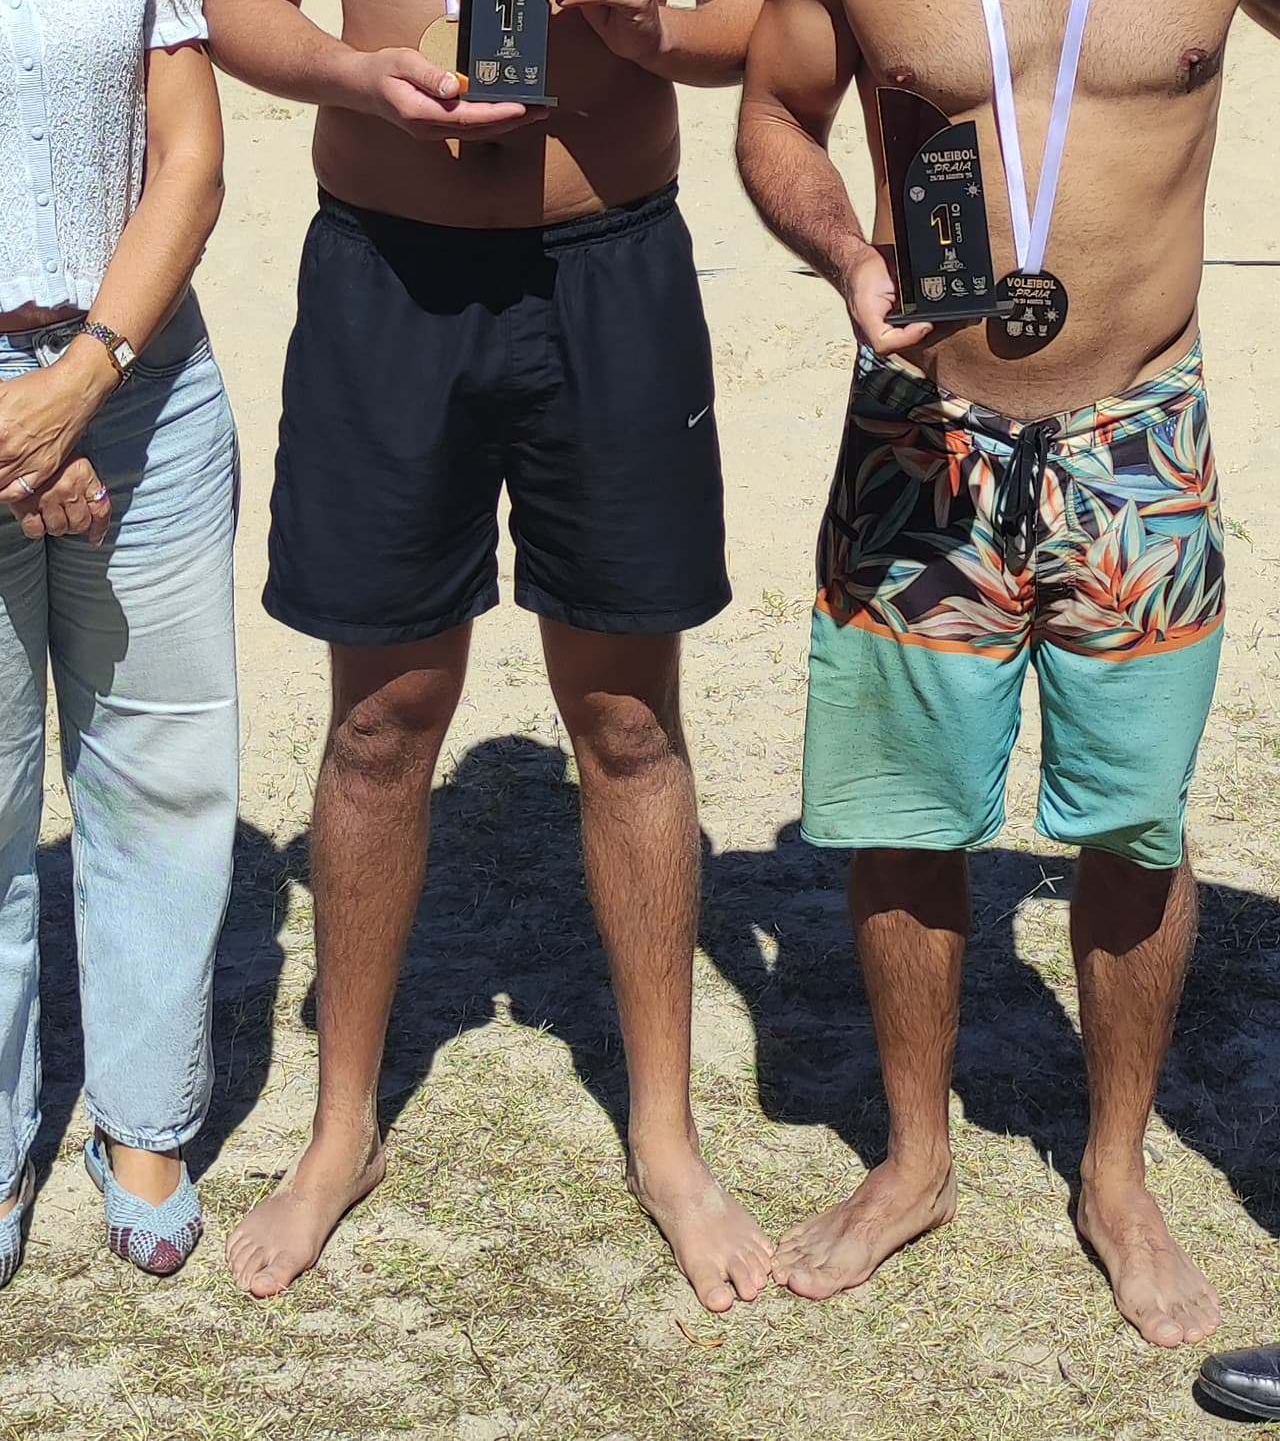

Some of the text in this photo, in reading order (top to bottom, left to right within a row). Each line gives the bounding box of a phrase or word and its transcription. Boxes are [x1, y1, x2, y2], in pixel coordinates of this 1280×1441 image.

[921, 149, 977, 164] VOLEIBOL
[933, 161, 972, 174] PRAIA
[1006, 277, 1057, 290] VOLEIBOL
[1014, 288, 1051, 299] PRAIA
